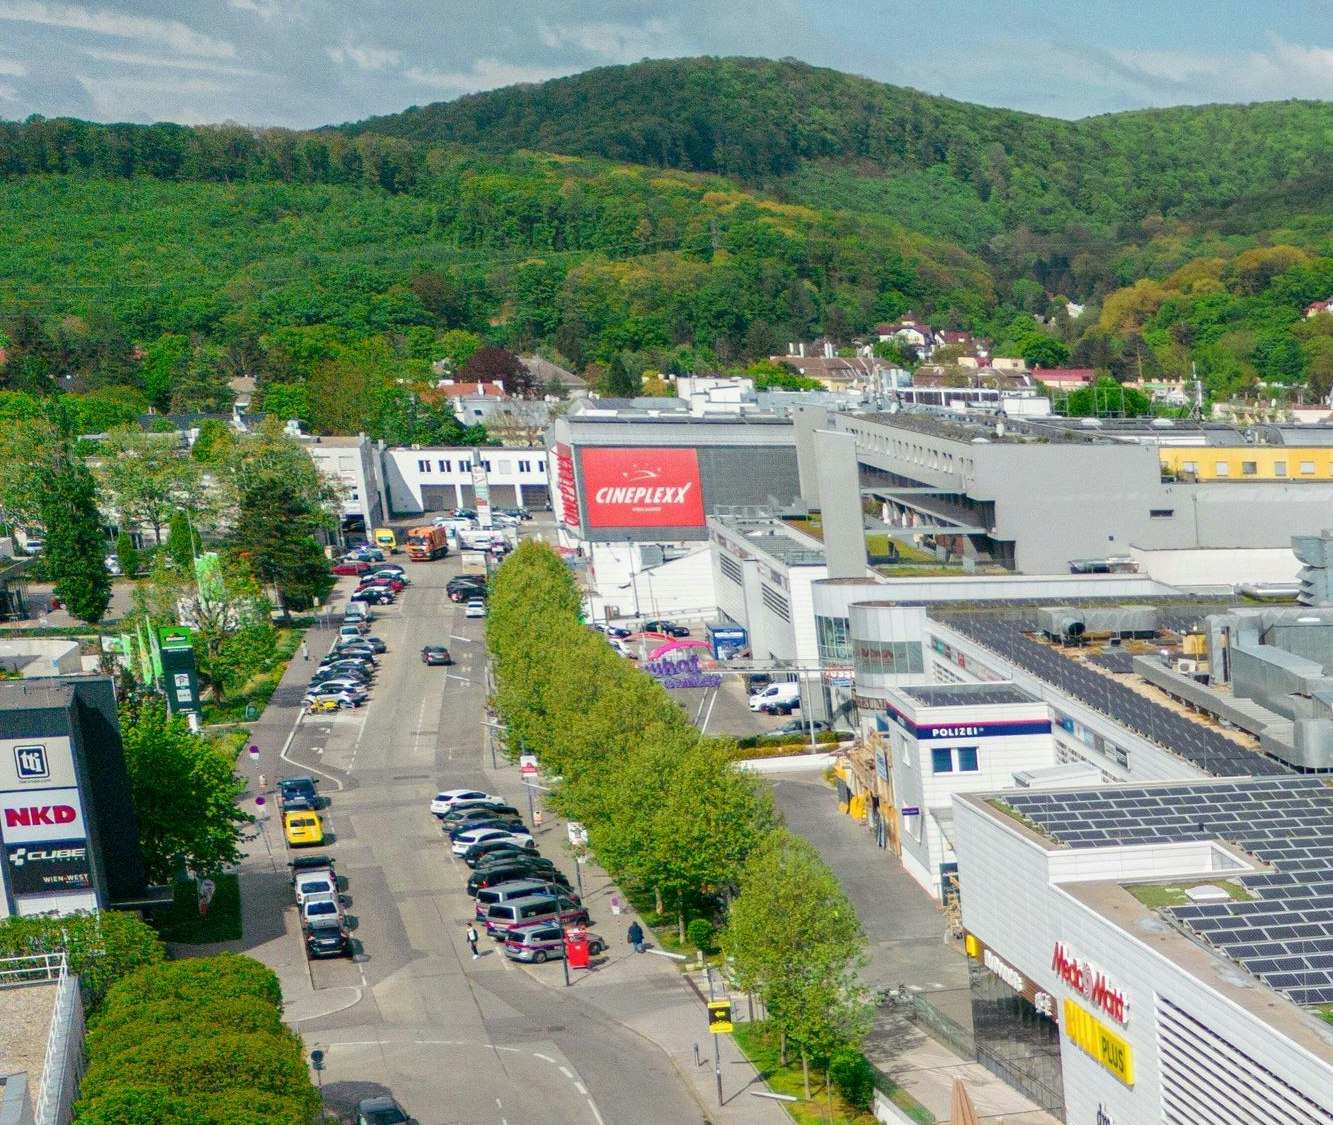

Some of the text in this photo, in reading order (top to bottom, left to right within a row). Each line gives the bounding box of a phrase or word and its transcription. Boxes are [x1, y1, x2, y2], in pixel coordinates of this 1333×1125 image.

[595, 482, 692, 504] CINEPLEXX
[932, 727, 978, 737] POLIZEI
[20, 751, 44, 773] tti
[4, 805, 77, 828] NKD
[27, 848, 86, 860] CUBE
[1101, 1036, 1124, 1073] PLUS
